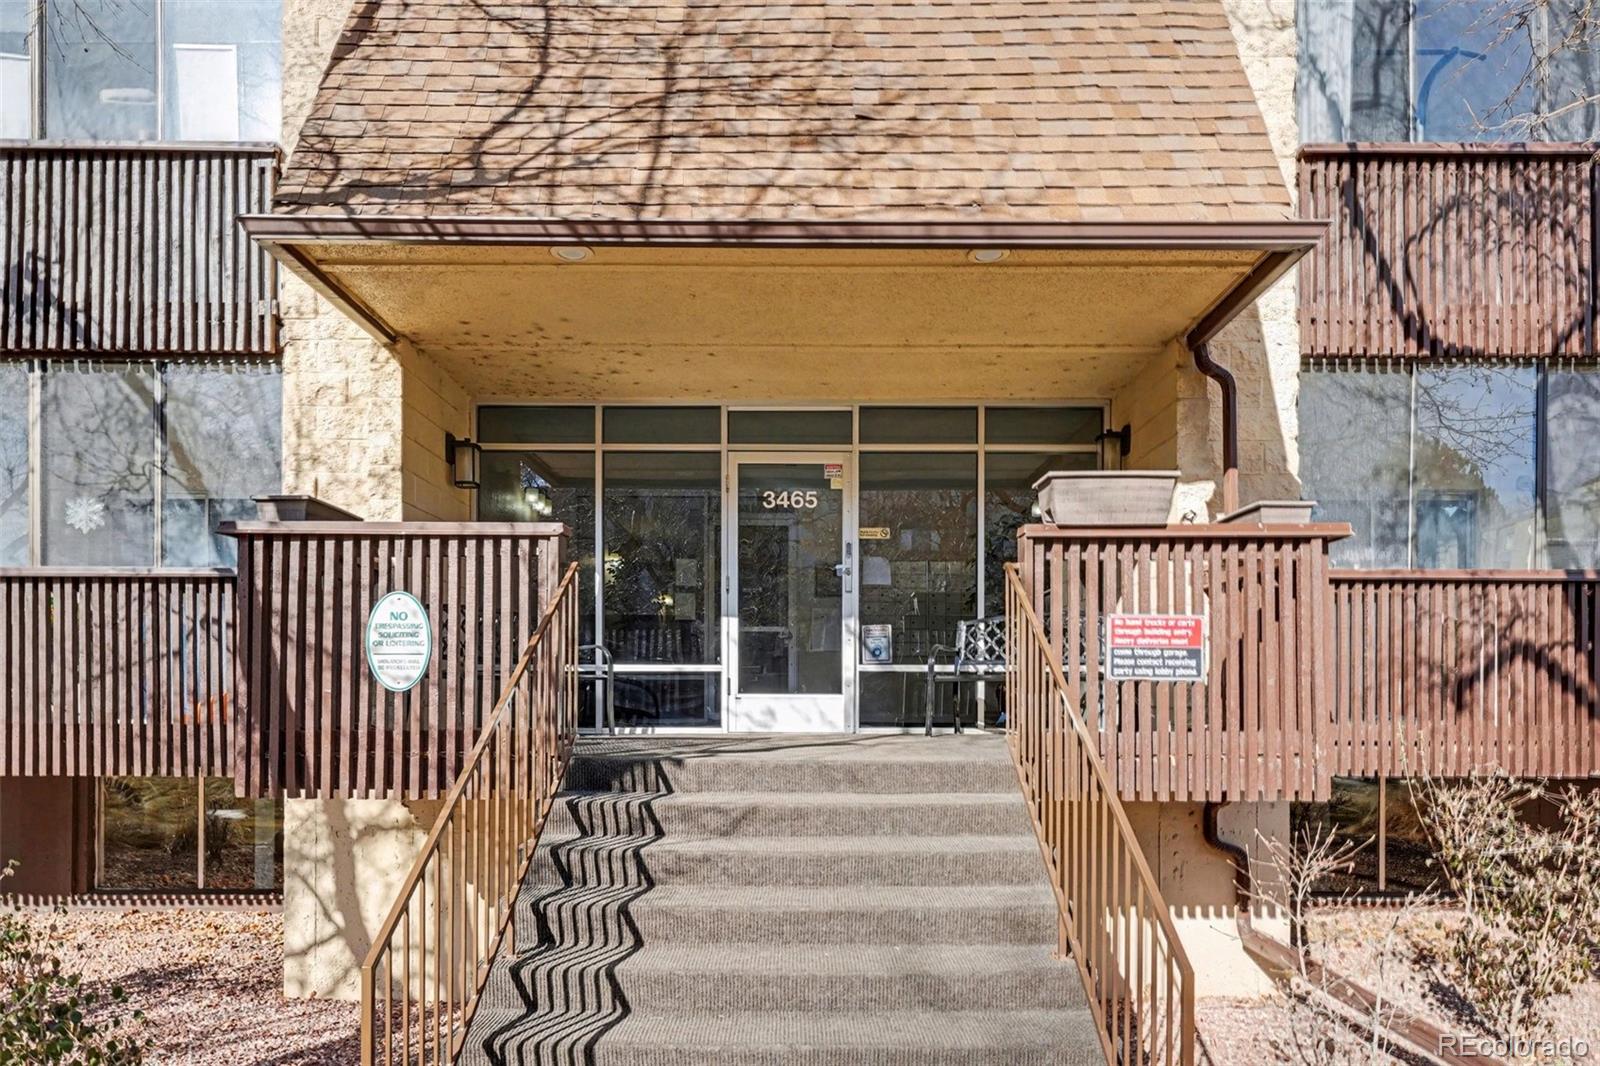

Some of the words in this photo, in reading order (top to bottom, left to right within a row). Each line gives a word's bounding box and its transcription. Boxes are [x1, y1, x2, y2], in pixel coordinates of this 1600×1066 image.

[762, 491, 818, 509] 3465
[390, 611, 408, 621] NO
[1125, 618, 1142, 626] hand
[378, 631, 419, 639] SOLICITING
[1114, 628, 1142, 636] through
[1143, 628, 1171, 636] building
[1134, 649, 1161, 657] through
[1137, 658, 1163, 666] contact
[1165, 659, 1196, 667] receiving
[1113, 668, 1133, 676] party
[1134, 668, 1153, 676] using
[1154, 667, 1174, 676] lobby
